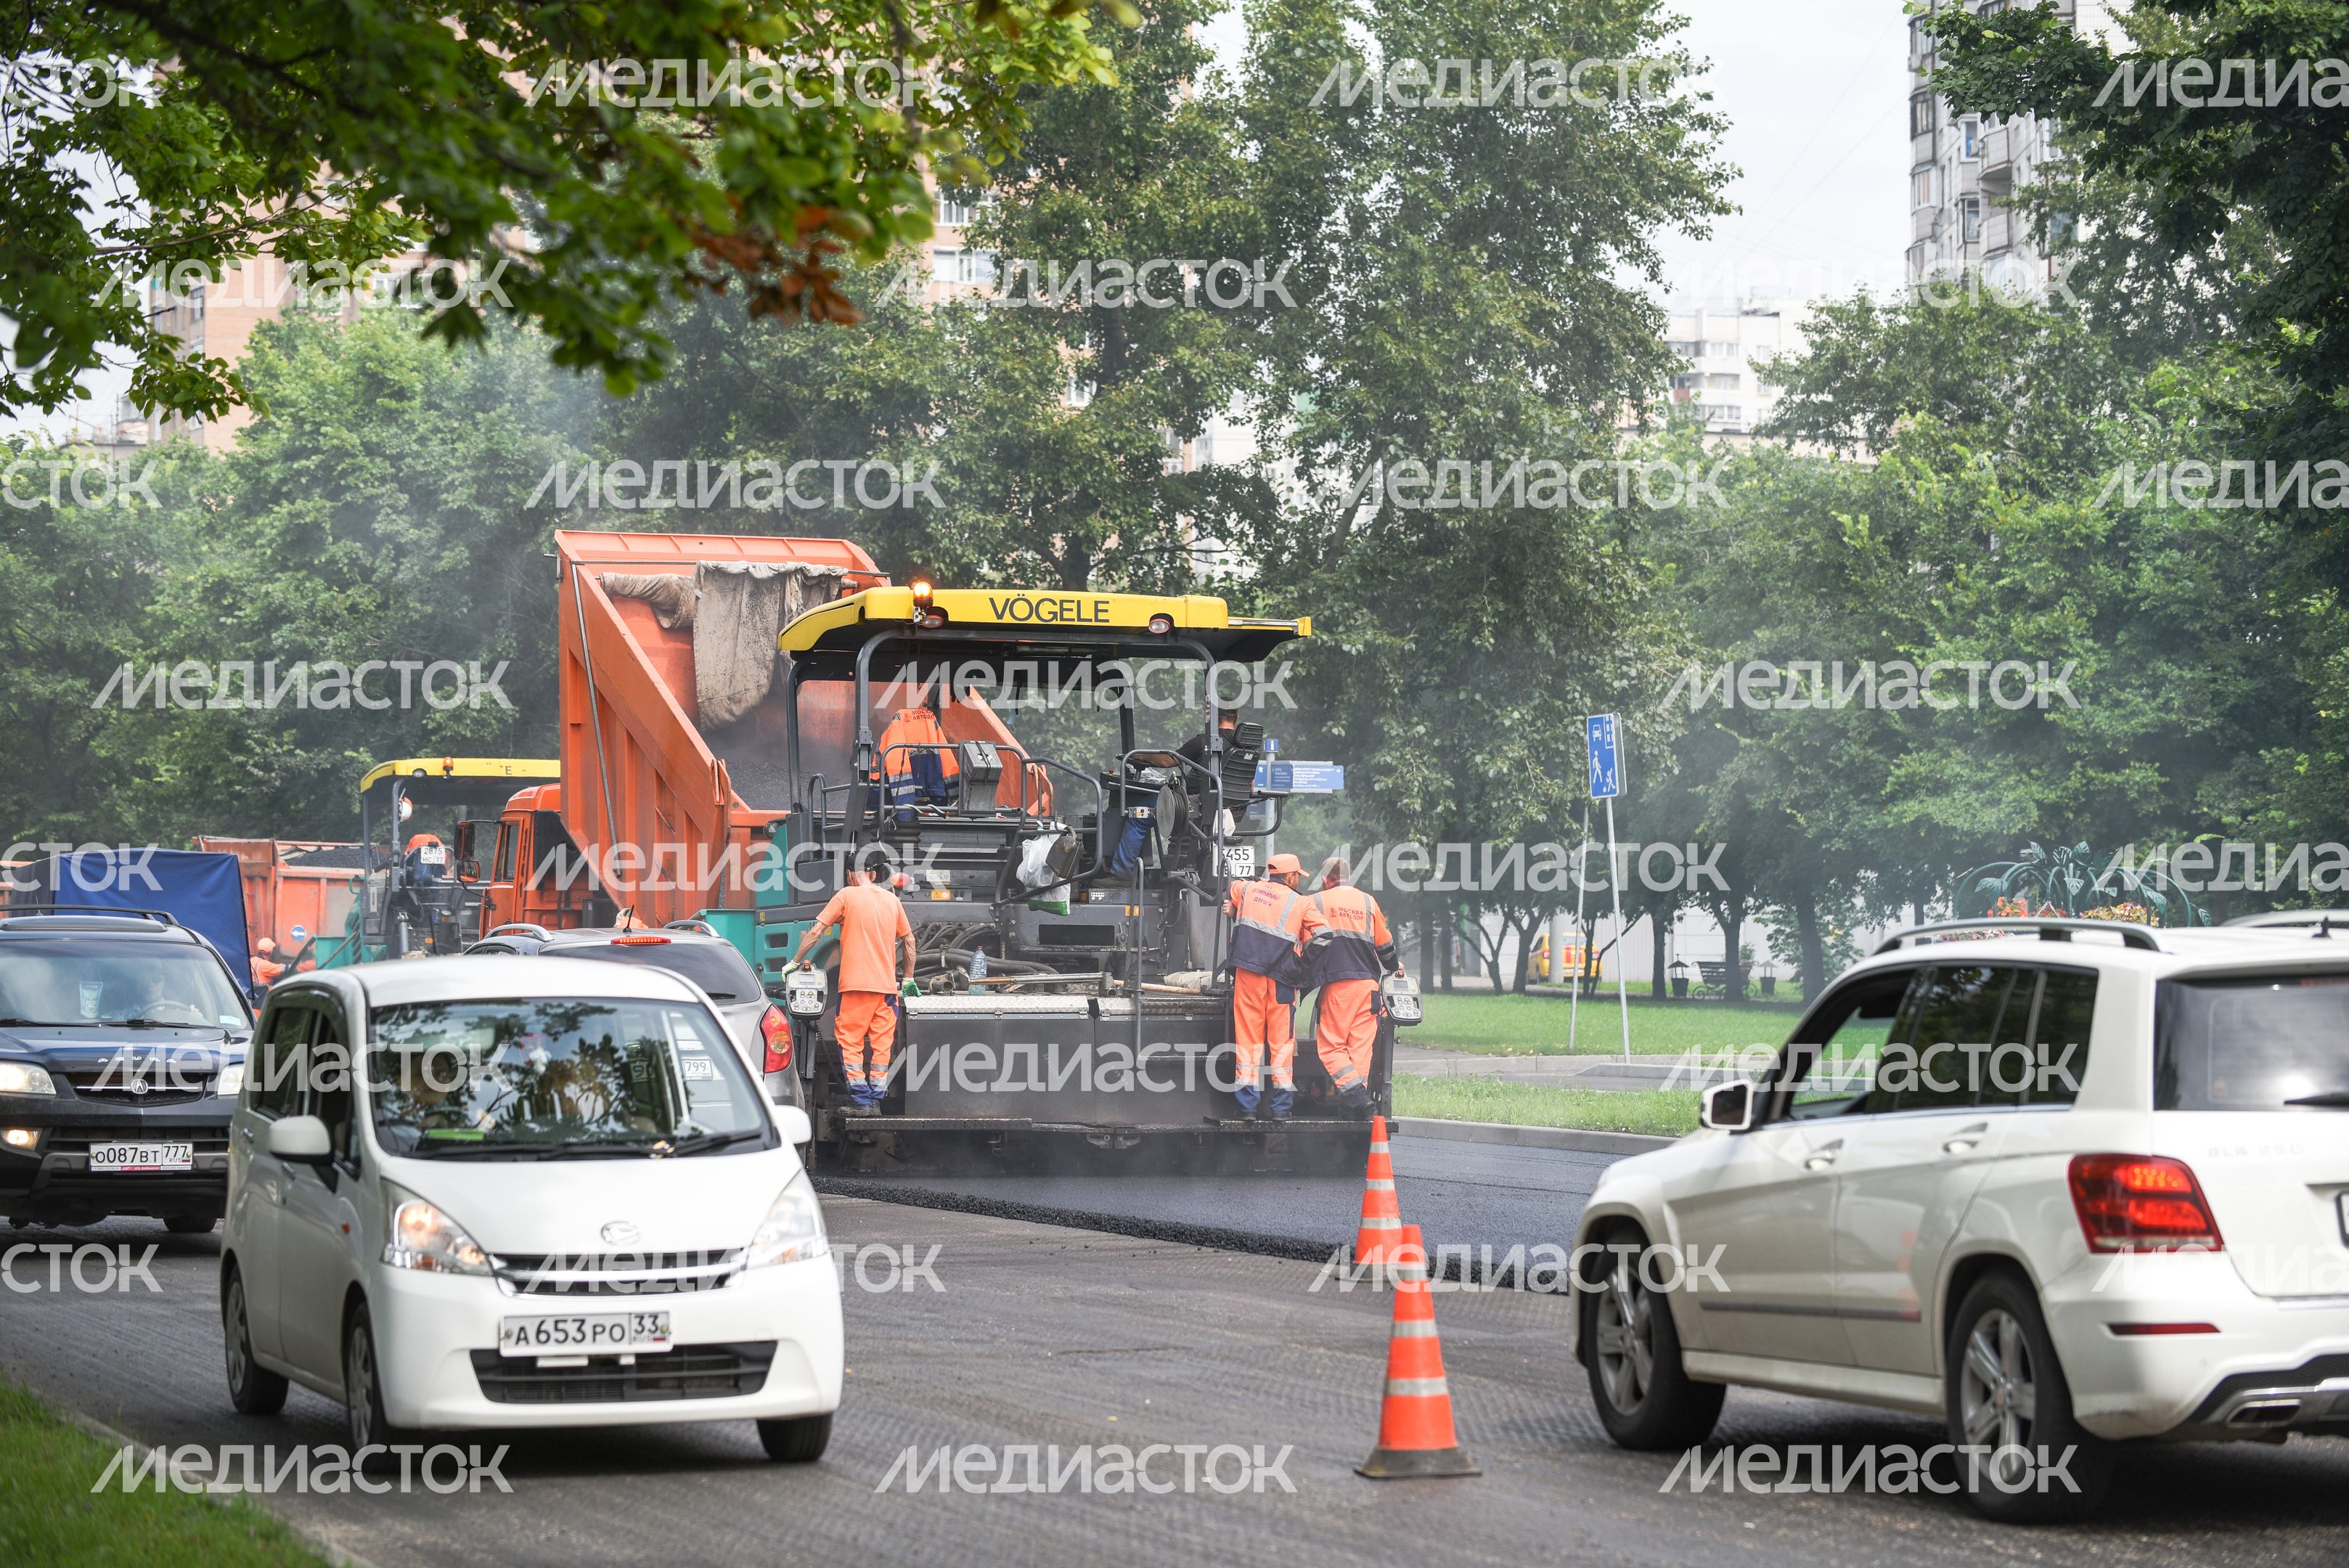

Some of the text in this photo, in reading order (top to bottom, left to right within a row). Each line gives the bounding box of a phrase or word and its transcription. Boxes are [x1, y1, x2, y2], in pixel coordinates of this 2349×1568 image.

[989, 593, 1110, 623] VÖGELE
[1223, 848, 1249, 861] 455
[1238, 865, 1251, 875] 77
[1338, 907, 1363, 915] МОСКВА
[1339, 912, 1364, 920] АВТОДОР
[163, 1146, 188, 1158] 777
[634, 1315, 659, 1334] 33
